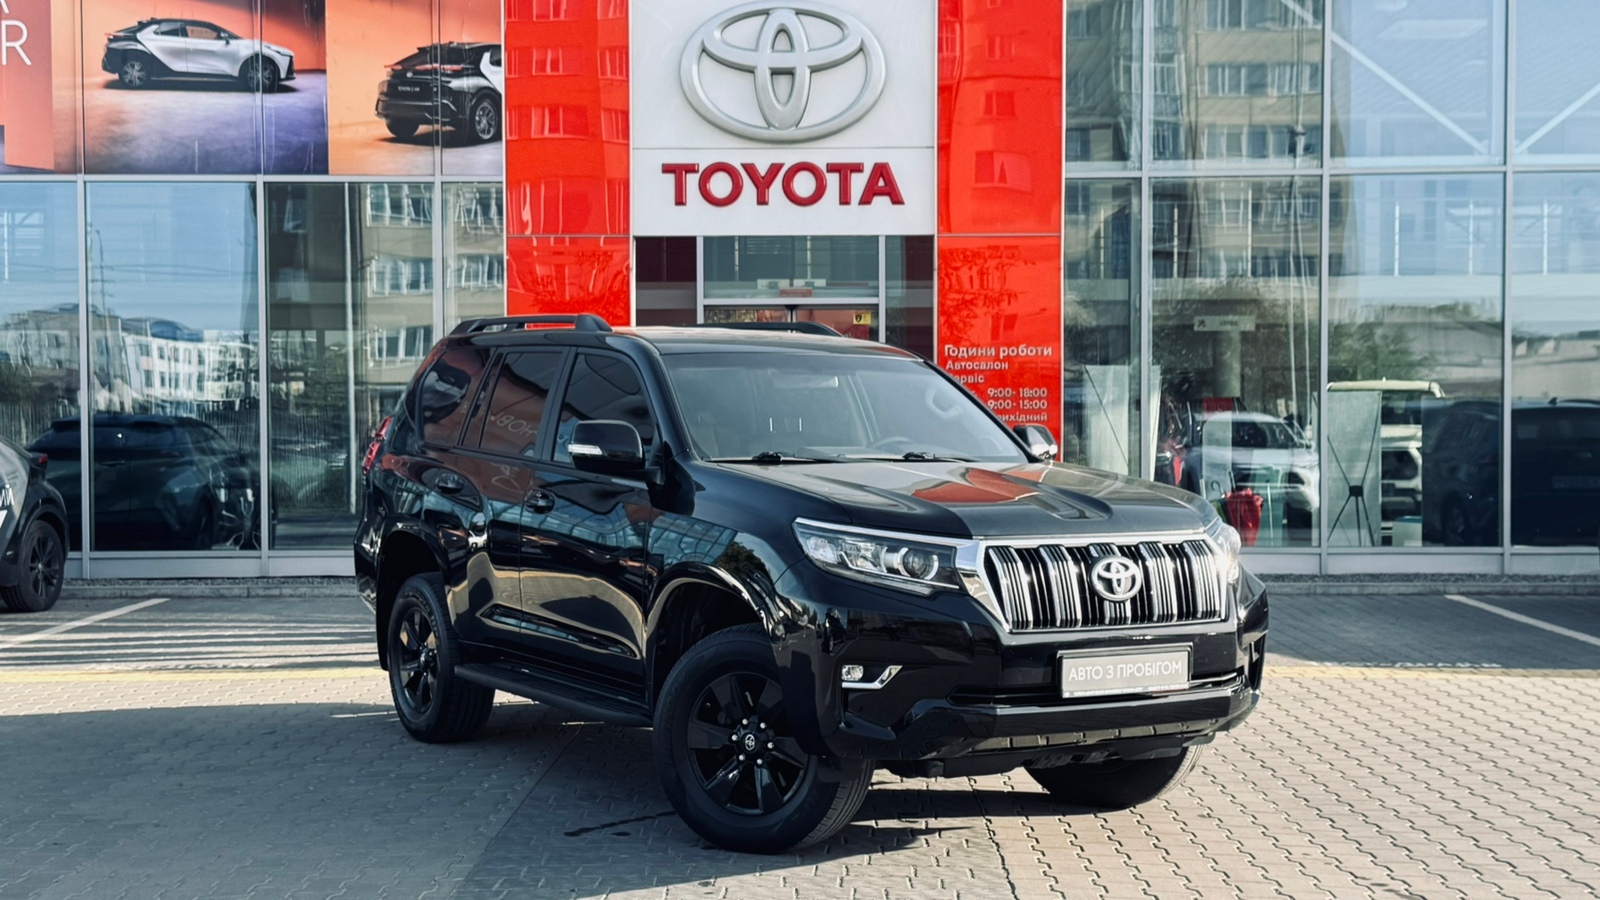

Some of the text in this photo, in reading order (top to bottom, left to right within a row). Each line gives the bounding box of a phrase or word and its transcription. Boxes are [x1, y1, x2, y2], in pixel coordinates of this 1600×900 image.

[661, 161, 905, 207] TOYOTA
[944, 344, 1052, 359] Години роботи
[946, 360, 1009, 370] Автосалон
[1068, 660, 1182, 682] АВТО З ПРОБІГОМ
